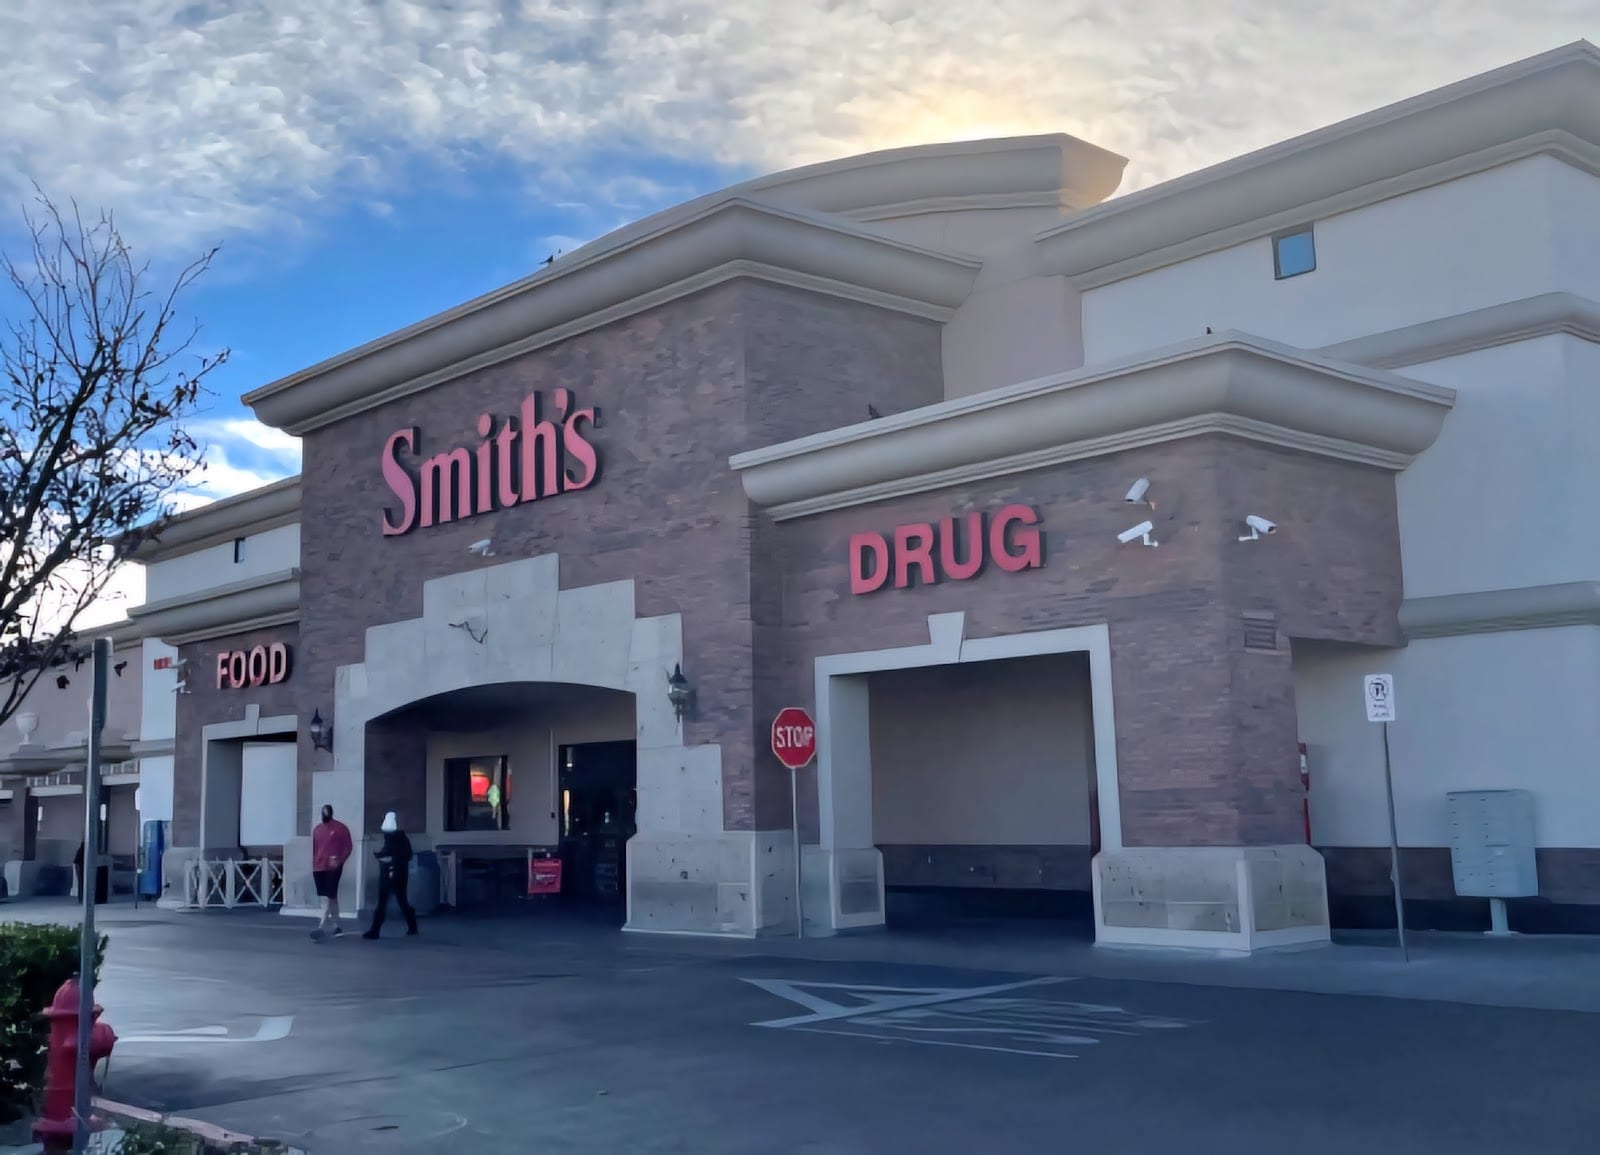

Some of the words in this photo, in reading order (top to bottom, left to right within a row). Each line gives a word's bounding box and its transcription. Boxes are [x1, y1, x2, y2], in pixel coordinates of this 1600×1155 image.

[382, 387, 599, 536] Smith's
[850, 503, 1041, 595] DRUG
[216, 642, 288, 689] FOOD
[776, 725, 813, 748] STOP
